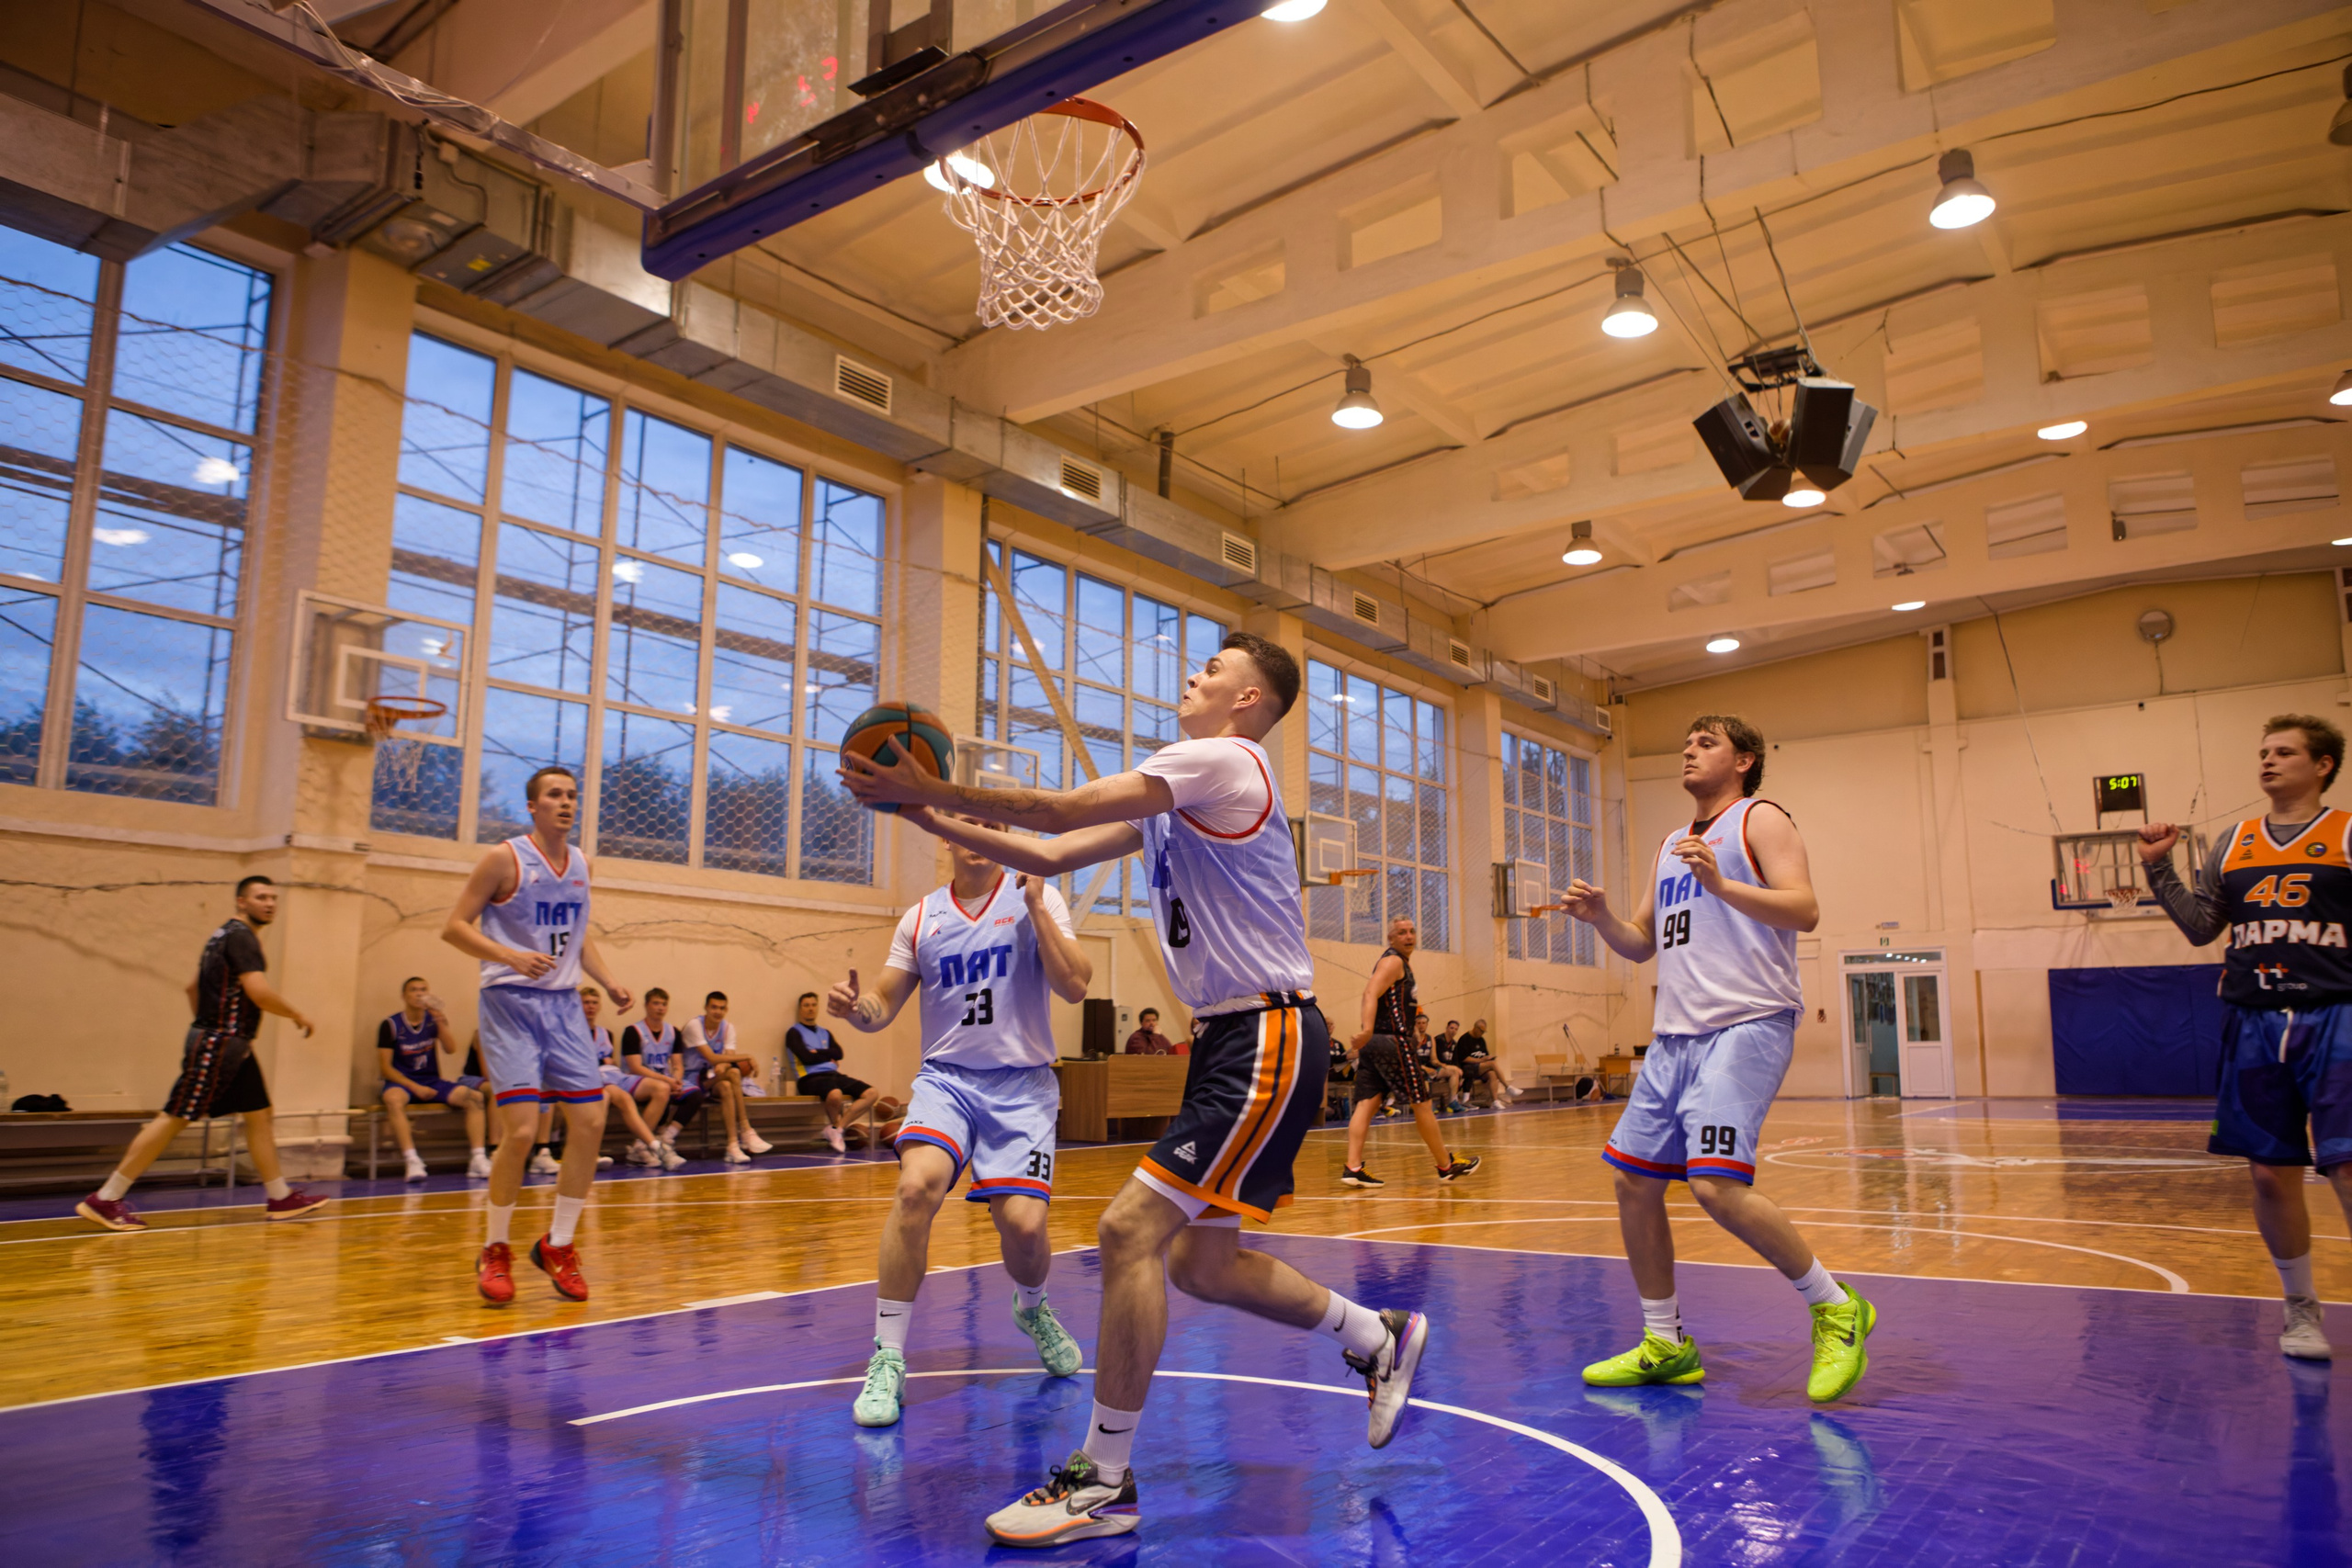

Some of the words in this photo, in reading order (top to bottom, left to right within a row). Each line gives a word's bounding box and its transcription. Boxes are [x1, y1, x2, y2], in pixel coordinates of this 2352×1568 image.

[2109, 775, 2138, 790] 5:07
[2244, 874, 2312, 908] 46
[536, 901, 582, 926] ПАТ
[1663, 909, 1691, 950] 99
[2233, 919, 2347, 950] ПАРМА
[939, 944, 1012, 988] ПАТ
[961, 987, 994, 1026] 33
[1702, 1125, 1736, 1156] 99
[1026, 1150, 1051, 1181] 33
